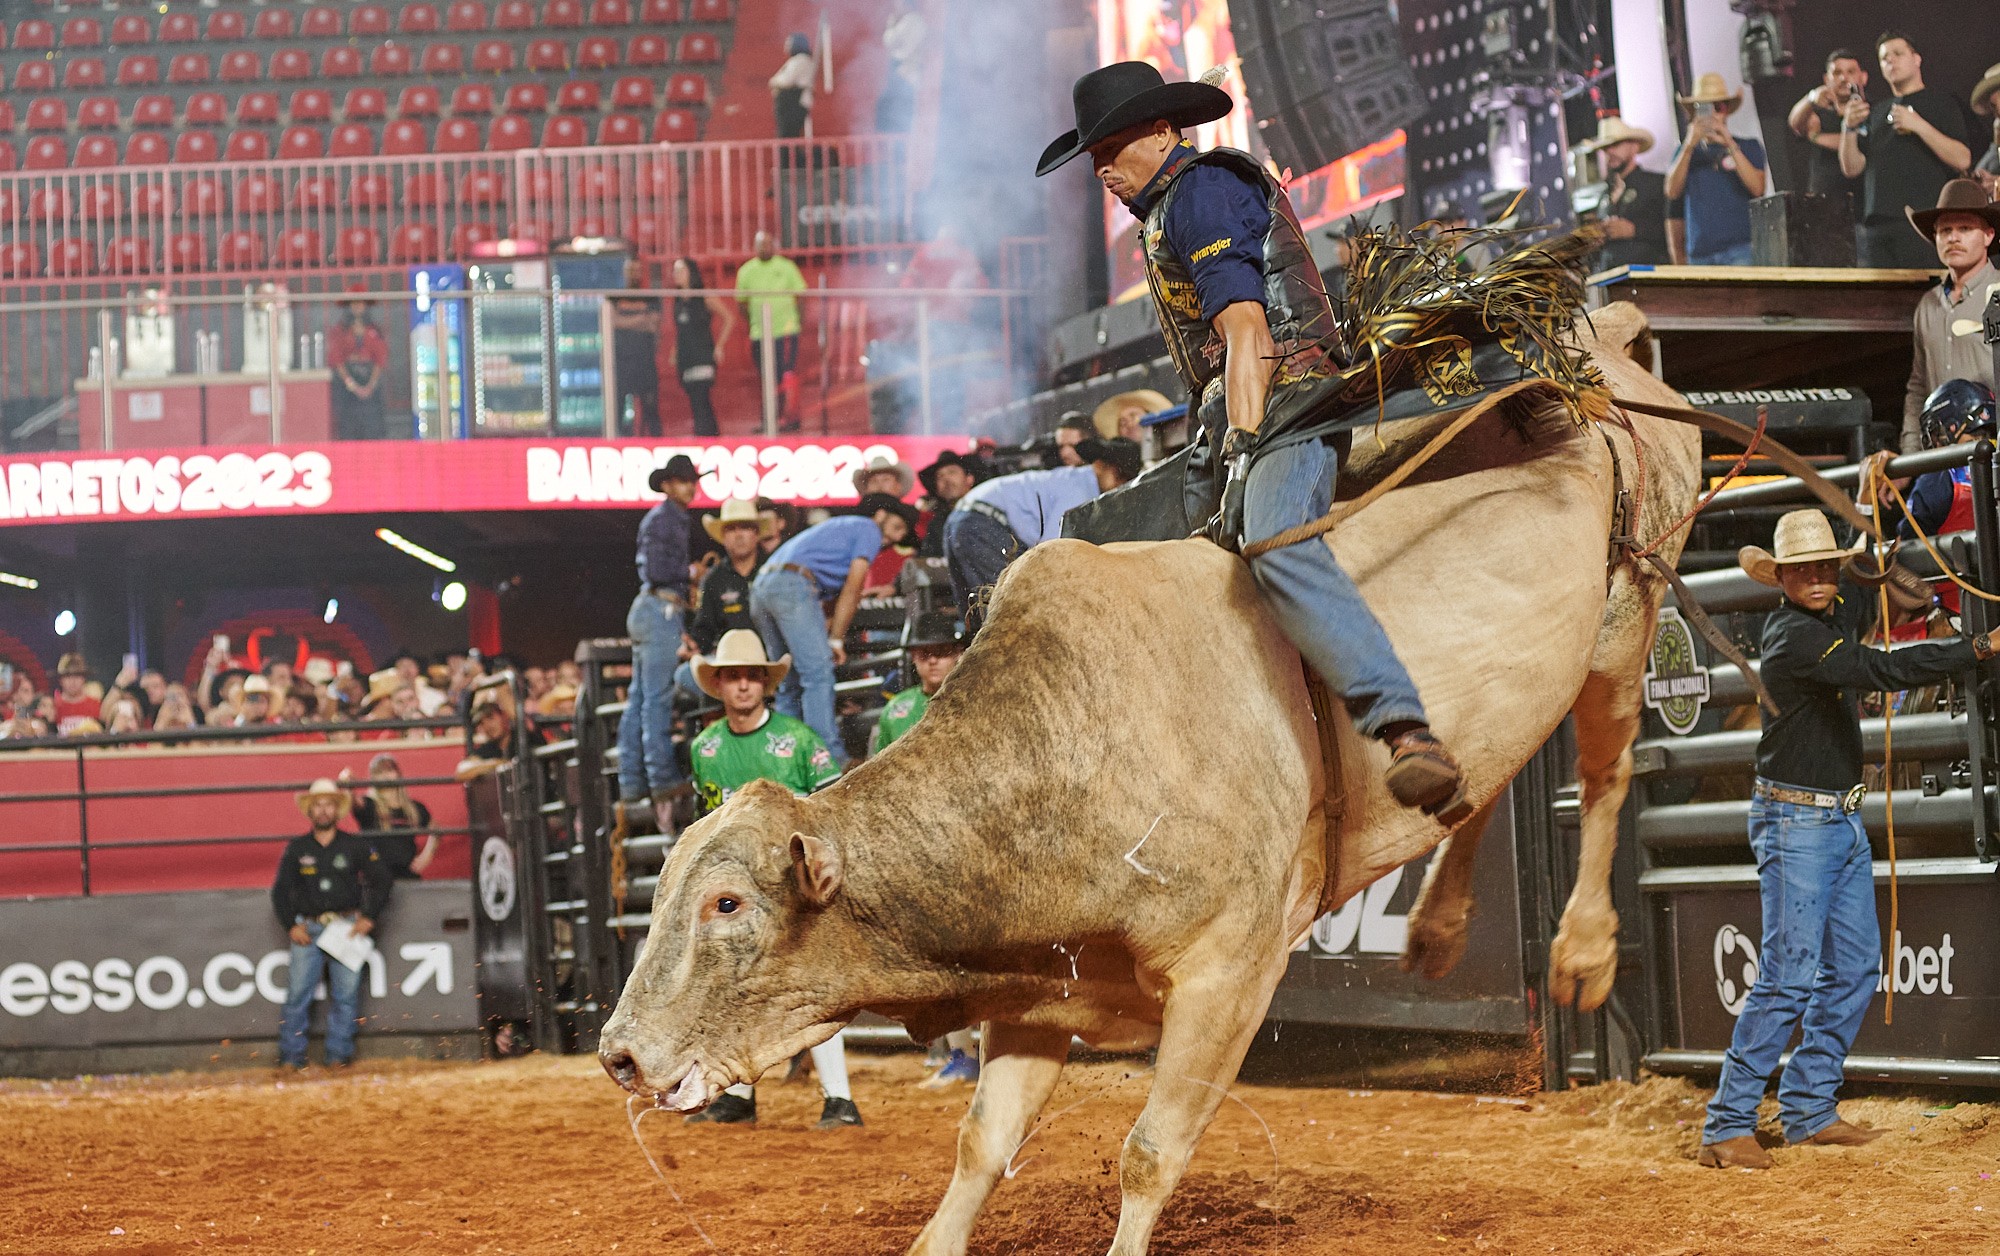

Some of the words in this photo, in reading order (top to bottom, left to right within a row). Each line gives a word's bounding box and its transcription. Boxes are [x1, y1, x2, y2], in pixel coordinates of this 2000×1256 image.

[1190, 237, 1232, 264] Wrangler
[1650, 679, 1671, 699] FINAL
[1670, 675, 1705, 697] NACIONAL
[1876, 930, 1955, 995] .bet
